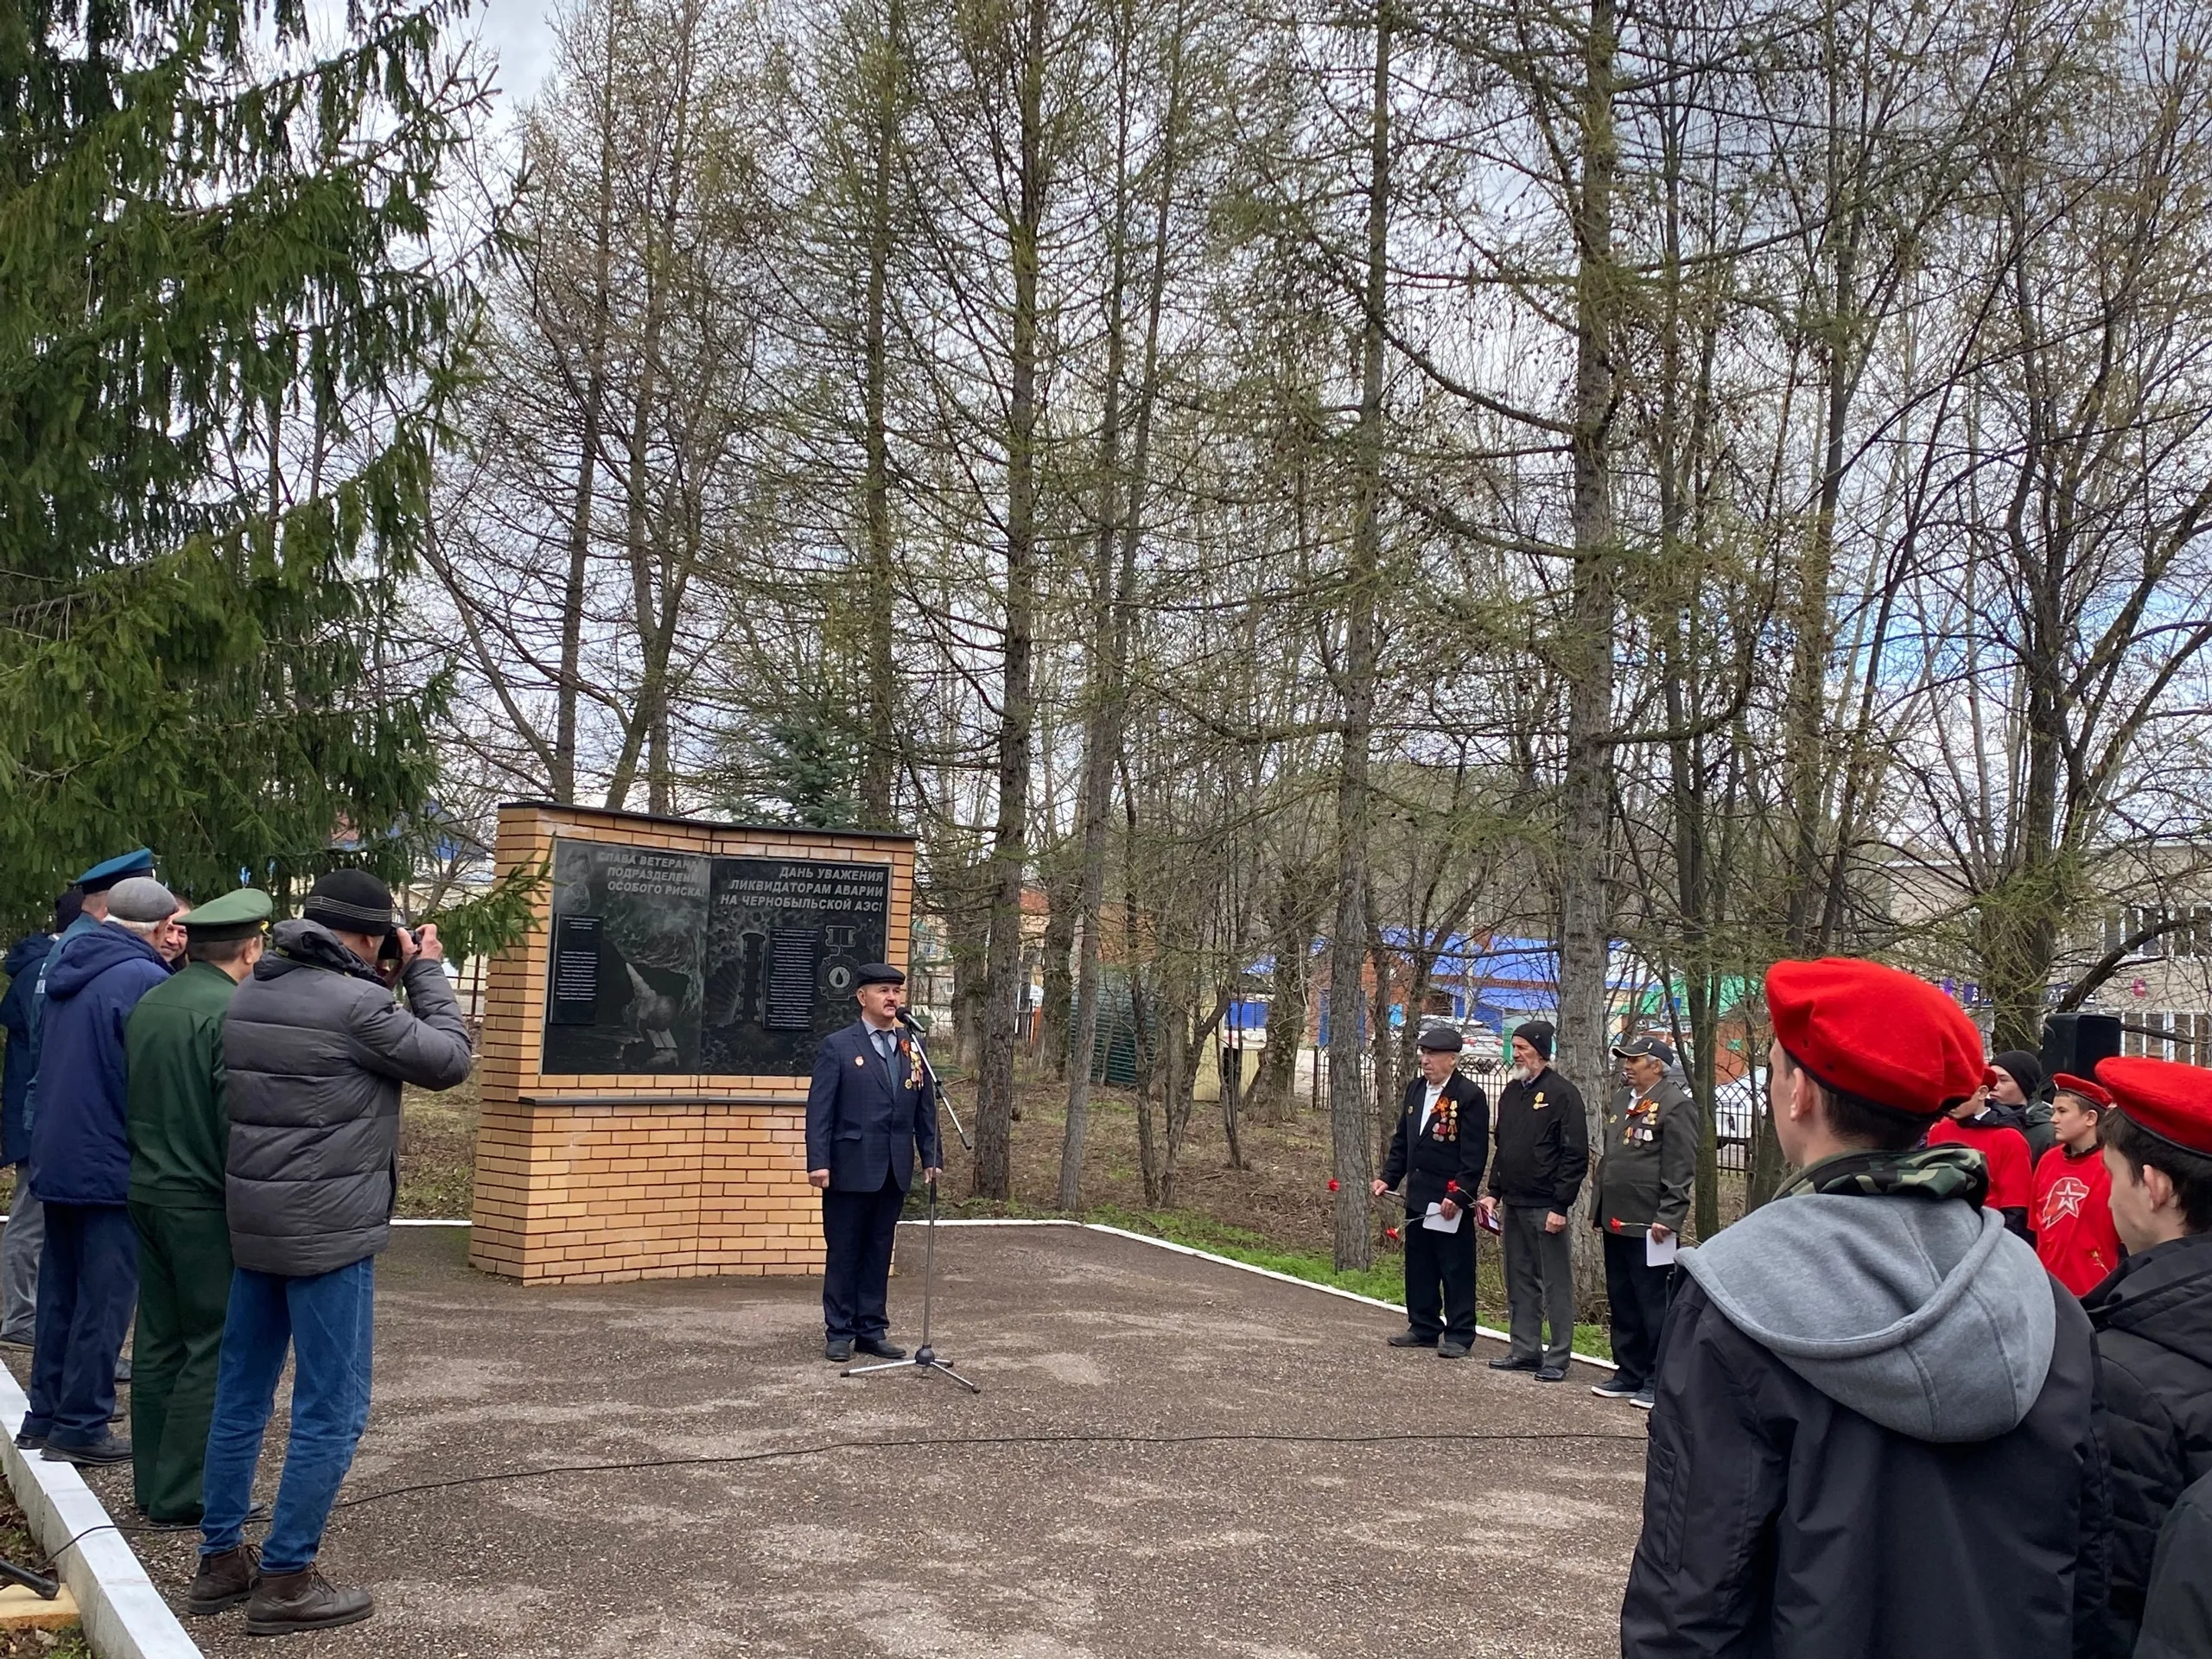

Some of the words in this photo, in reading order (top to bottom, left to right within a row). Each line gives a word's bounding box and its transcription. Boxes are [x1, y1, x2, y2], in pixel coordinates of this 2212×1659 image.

[597, 852, 636, 864] СЛАВА
[779, 867, 814, 879] ДАНЬ
[817, 868, 884, 882] УВАЖЕНИЯ
[607, 881, 662, 894] ОСОБОГО
[664, 885, 705, 897] РИСКА!
[729, 880, 831, 894] ЛИКВИДАТОРАМ
[834, 885, 883, 898] АВАРИИ
[720, 894, 738, 906] НА
[741, 895, 852, 912] ЧЕРНОБЫЛЬСКОЙ
[855, 901, 883, 912] АЭС!
